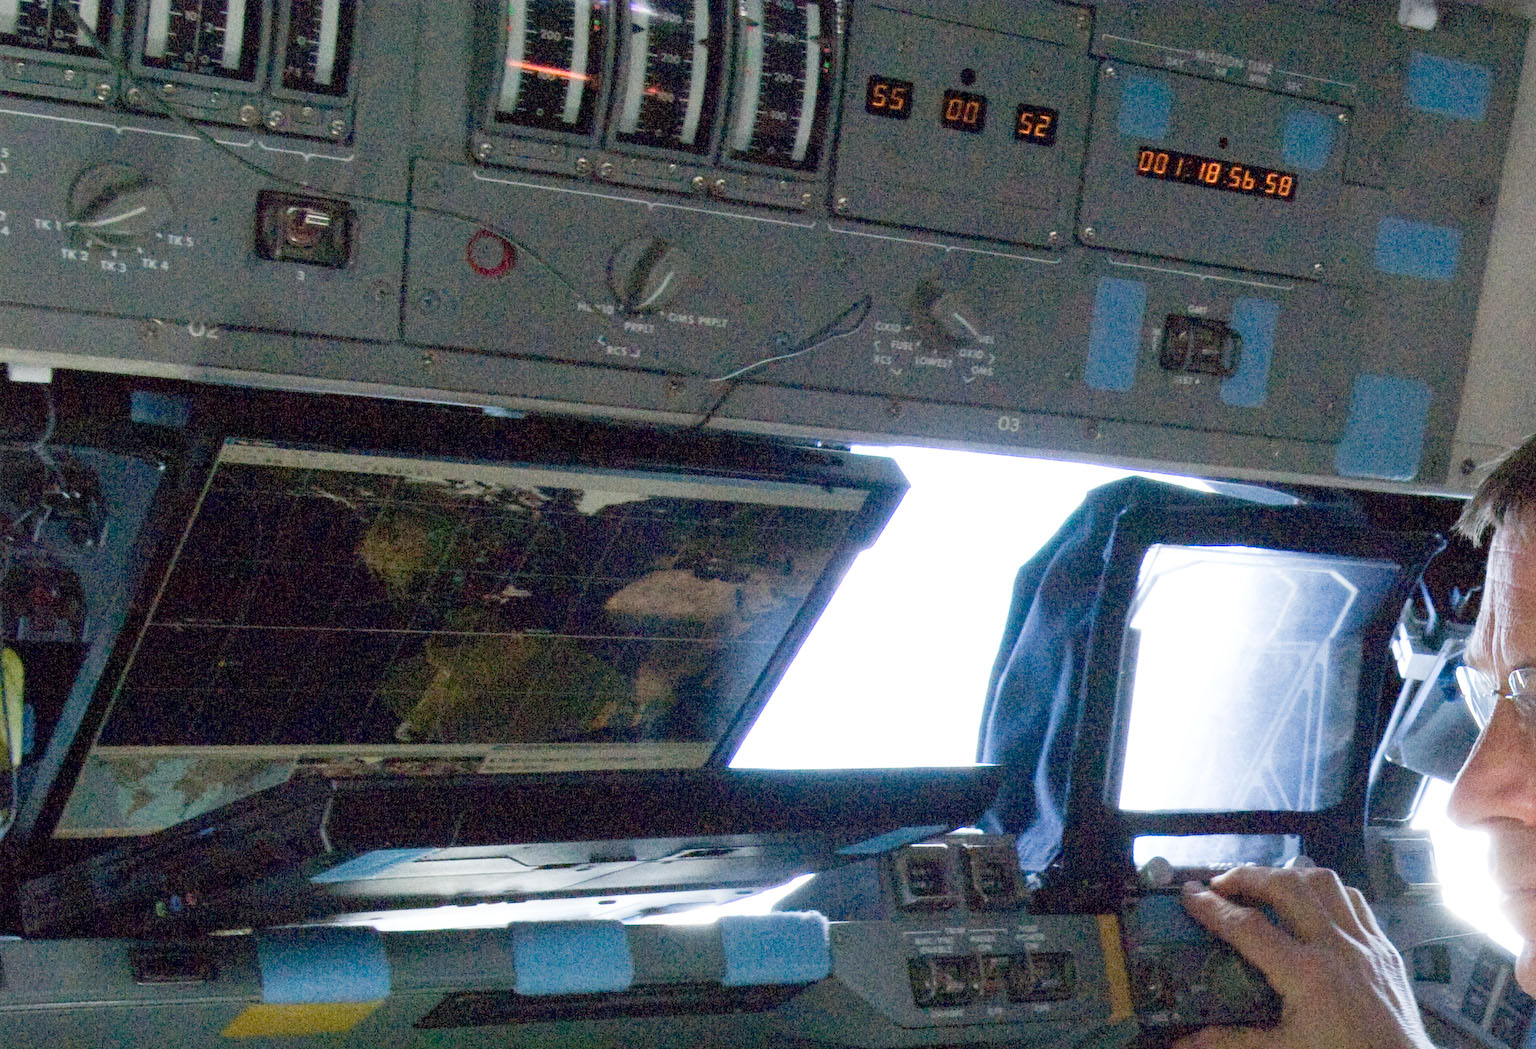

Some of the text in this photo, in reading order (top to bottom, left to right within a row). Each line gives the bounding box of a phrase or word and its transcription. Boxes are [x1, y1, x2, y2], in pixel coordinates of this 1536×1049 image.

[871, 84, 1052, 137] 55 00 52
